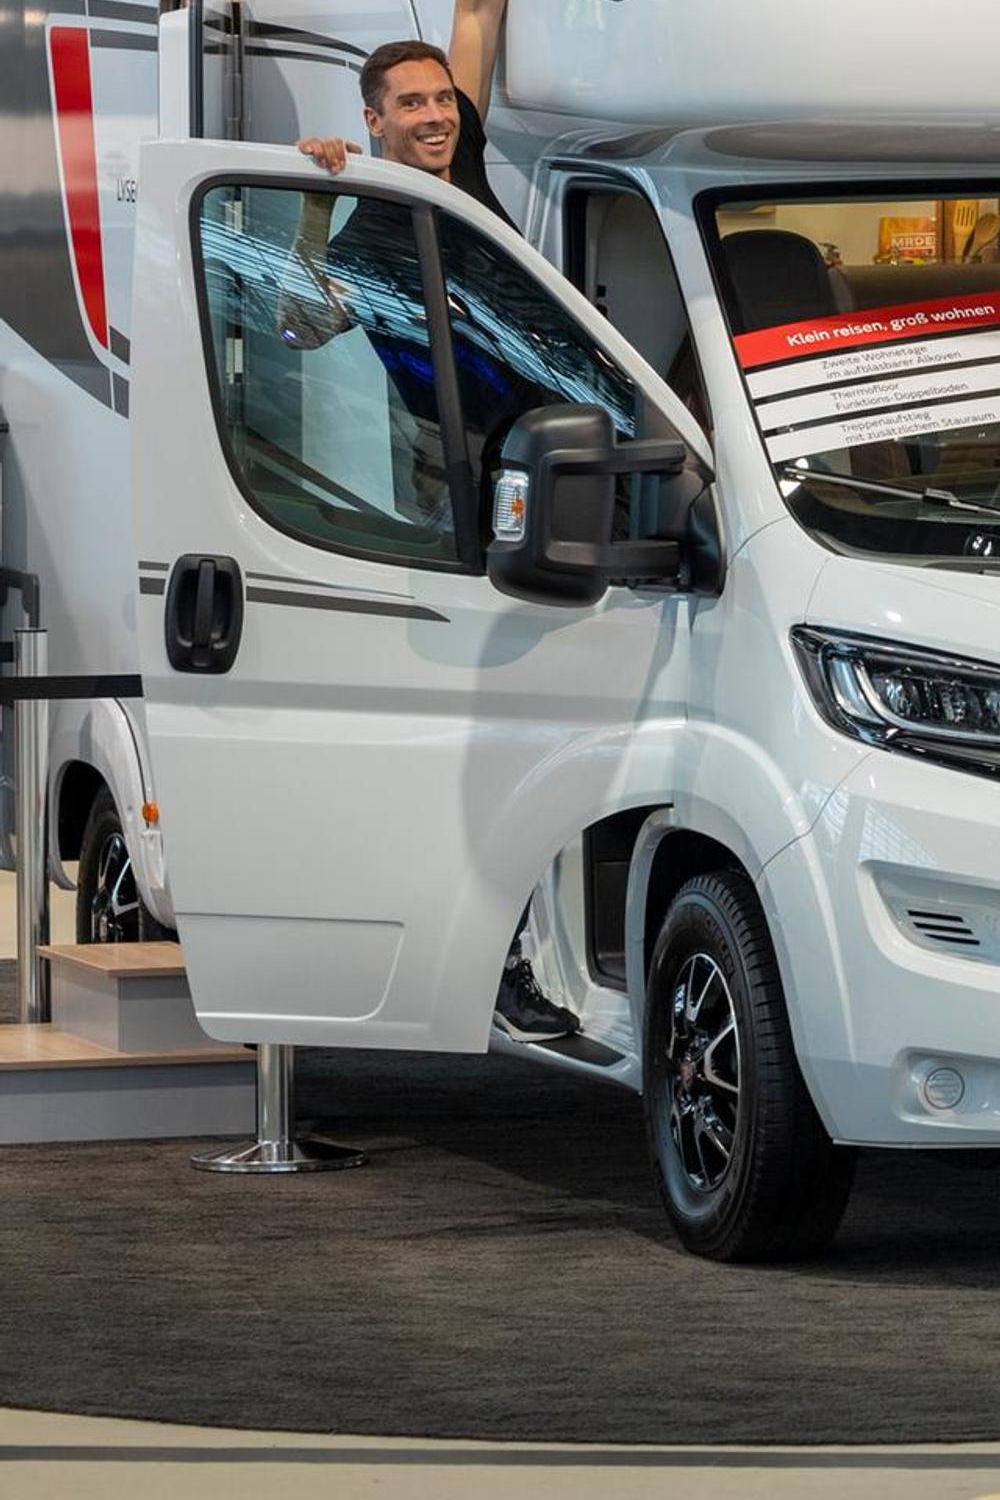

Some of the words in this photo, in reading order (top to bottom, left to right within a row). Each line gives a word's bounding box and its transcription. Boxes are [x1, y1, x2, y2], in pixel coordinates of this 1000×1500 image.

[117, 178, 139, 203] LYSE
[786, 329, 831, 347] Klein
[833, 319, 888, 338] reisen,
[889, 312, 929, 332] groß
[931, 304, 996, 323] wohnen
[822, 356, 858, 370] Zweite
[860, 346, 928, 362] Wohnetage
[826, 371, 842, 380] im
[840, 411, 932, 434] Treppenaufstieg
[845, 433, 866, 445] mit
